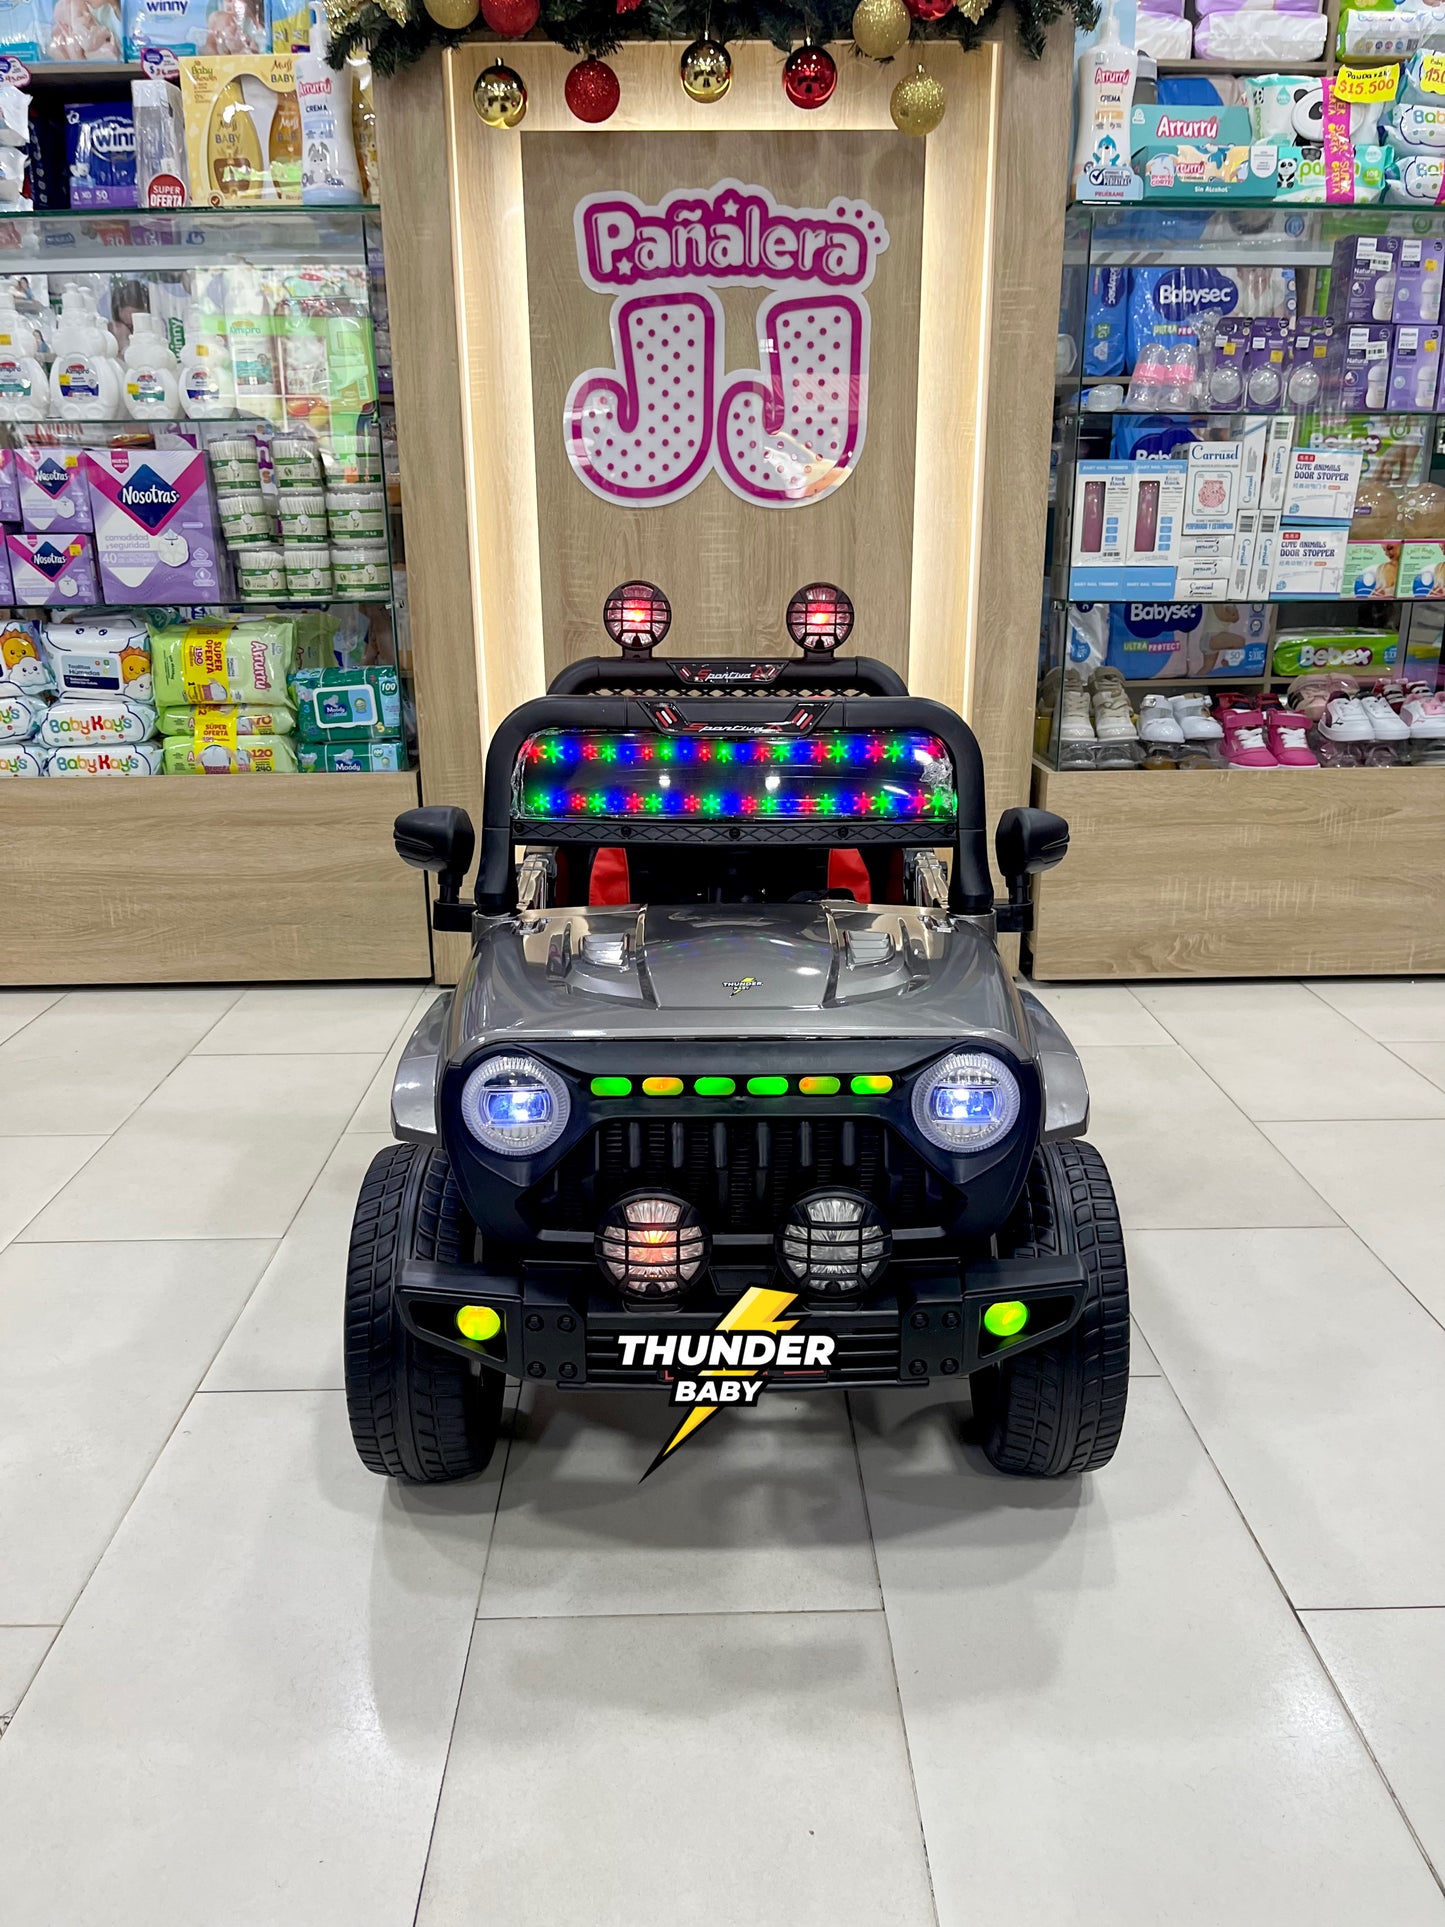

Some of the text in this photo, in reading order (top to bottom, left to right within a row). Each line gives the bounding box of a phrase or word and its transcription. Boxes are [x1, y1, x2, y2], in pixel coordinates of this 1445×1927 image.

[146, 0, 188, 14] winny
[271, 73, 294, 84] BABY
[1094, 67, 1131, 86] Arrurrú
[1338, 79, 1395, 95] $15.500
[306, 104, 328, 113] CREMA
[1157, 115, 1218, 138] Arrurrú
[153, 185, 181, 194] SUPER
[150, 194, 183, 207] OFERTA
[591, 204, 861, 277] Pañalera
[1159, 284, 1232, 306] Babysec
[1191, 444, 1240, 460] Carrusel
[35, 470, 69, 482] Nosotras
[1294, 472, 1349, 481] DOOR STOPPER
[122, 484, 177, 505] Nosotras
[109, 542, 150, 551] seguridad
[1299, 541, 1326, 549] ANIMALS
[33, 552, 66, 564] Nosotras
[102, 552, 118, 563] 40
[1280, 549, 1335, 557] DOOR STOPPER
[1130, 603, 1197, 622] Babysec
[1124, 642, 1180, 652] ULTRA PROTECT
[194, 646, 203, 666] 190
[205, 639, 214, 674] OFERTA
[251, 641, 271, 690] Arrurrú
[381, 683, 396, 691] 100
[251, 749, 273, 758] 120
[335, 764, 361, 772] Moody
